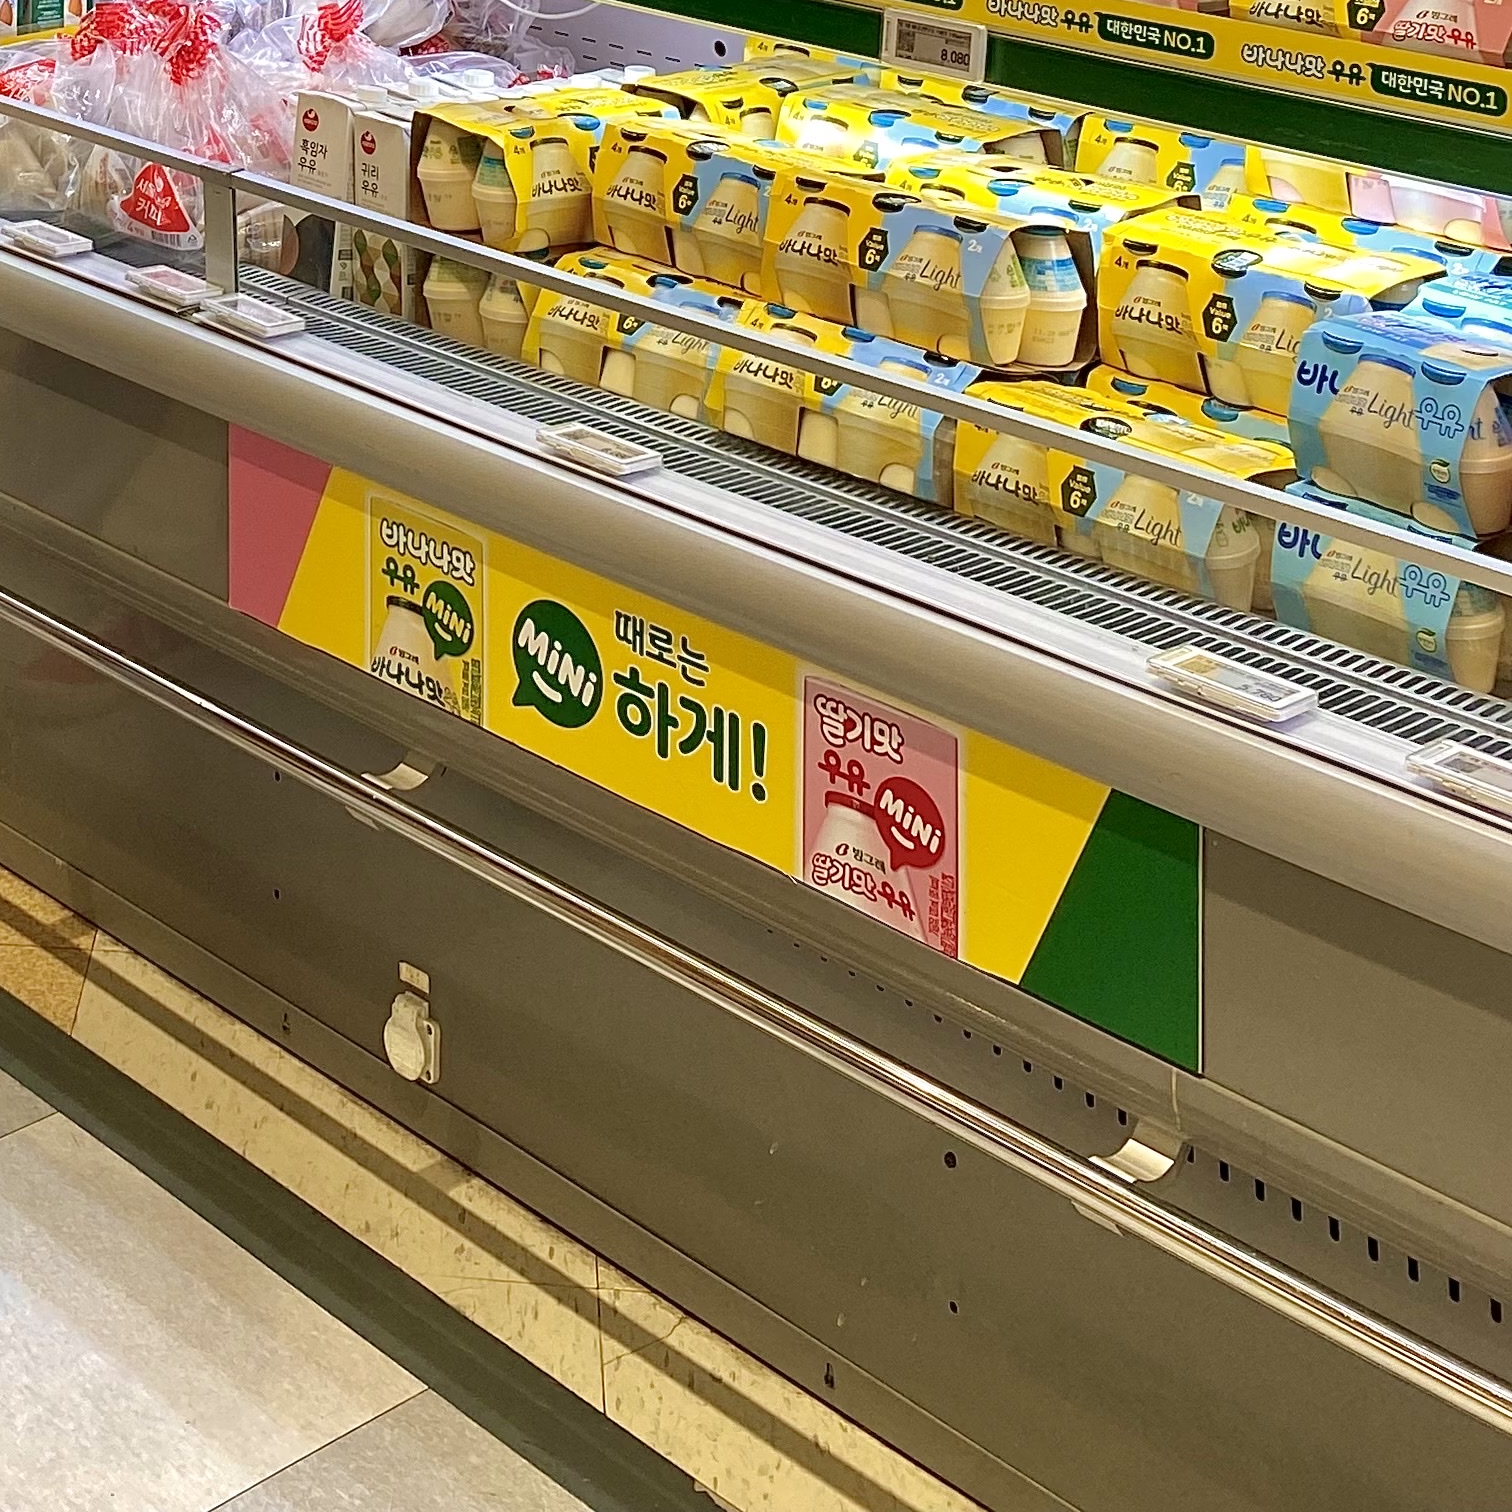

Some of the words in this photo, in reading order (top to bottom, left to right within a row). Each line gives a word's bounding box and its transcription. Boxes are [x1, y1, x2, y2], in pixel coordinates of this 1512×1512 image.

[1061, 7, 1094, 33] 우유
[1106, 18, 1161, 45] 대한민국
[1163, 29, 1206, 53] NO.1
[1241, 43, 1325, 79] 바나나맛
[1327, 59, 1366, 86] 우유
[1381, 70, 1446, 101] 대한민국
[1448, 82, 1498, 109] NO.1
[297, 157, 316, 175] 우유
[300, 138, 328, 157] 흑임자
[361, 162, 379, 179] 귀리
[361, 179, 379, 197] 우유
[921, 256, 963, 292] Light
[1114, 306, 1184, 335] 바나나맛
[1209, 307, 1232, 319] Value
[1367, 390, 1416, 427] Light
[1418, 397, 1465, 439] 우유
[973, 470, 1039, 505] 바나나맛
[1134, 511, 1181, 546] Light
[380, 517, 475, 586] 바나나맛
[382, 557, 419, 594] 우유
[398, 650, 419, 664] 빙그레
[615, 610, 710, 688] 때로는
[370, 656, 444, 708] 바나나맛
[612, 666, 767, 802] 하게!
[814, 694, 904, 764] 딸기맛
[818, 749, 871, 796] 우유
[852, 847, 886, 874] 빙그레
[811, 852, 877, 902] 딸기맛
[878, 881, 916, 921] 우유
